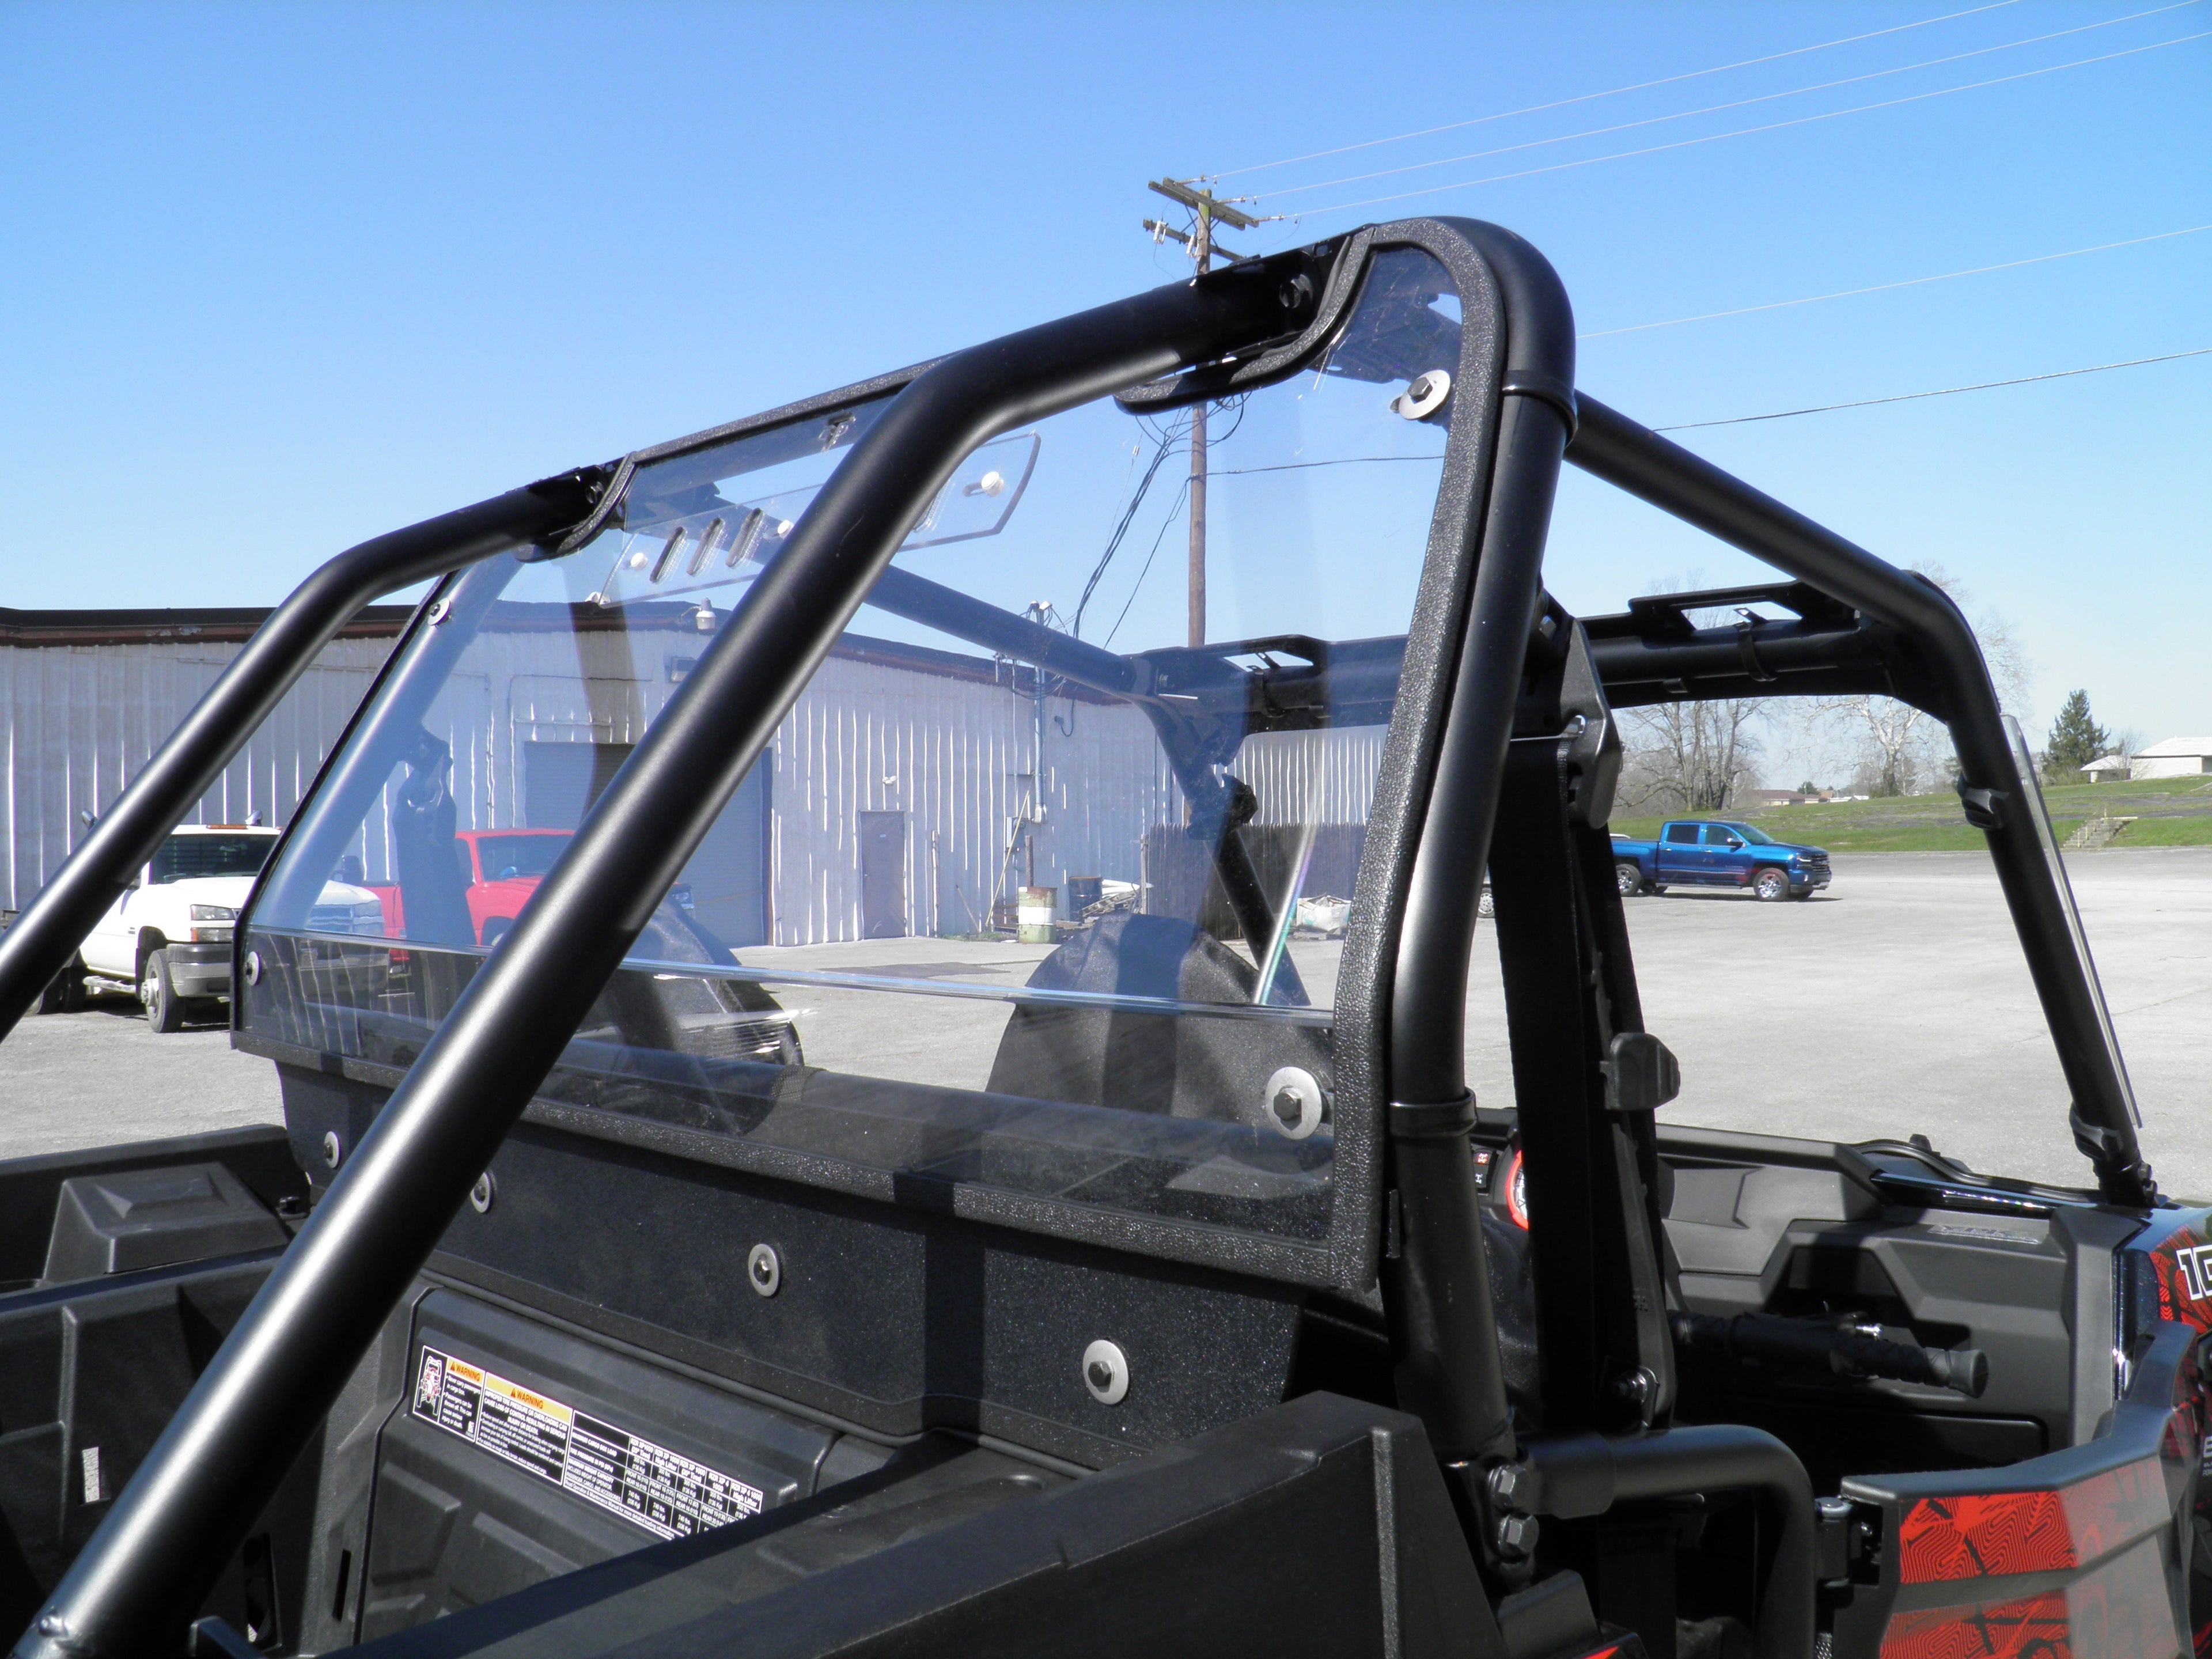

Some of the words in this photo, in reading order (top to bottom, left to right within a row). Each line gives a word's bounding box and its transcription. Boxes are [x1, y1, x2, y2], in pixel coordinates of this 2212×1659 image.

[456, 1363, 480, 1381] WARNING
[516, 1390, 543, 1409] WARNING
[484, 1397, 495, 1407] CAUSE
[495, 1402, 505, 1411] LOSS
[509, 1408, 525, 1421] CONTROL
[510, 1401, 528, 1414] PRESSURE
[533, 1411, 559, 1428] OVERLOADING
[559, 1422, 567, 1431] CAN
[630, 1437, 639, 1447] RZR
[607, 1447, 617, 1457] LOAD
[654, 1448, 664, 1457] RZR
[663, 1452, 669, 1460] XP
[669, 1455, 679, 1465] 1000
[655, 1456, 665, 1467] High
[665, 1460, 677, 1472] Lifter
[680, 1459, 688, 1469] RZR
[688, 1463, 695, 1472] XP
[695, 1466, 706, 1477] 1000
[597, 1471, 613, 1484] CAPACITY
[709, 1472, 718, 1482] RZR
[718, 1476, 725, 1486] XP
[725, 1479, 729, 1487] 4
[712, 1482, 724, 1493] 1000
[731, 1482, 741, 1493] RZR
[740, 1486, 747, 1495] XP
[733, 1491, 744, 1502] High
[744, 1496, 757, 1508] Lifter
